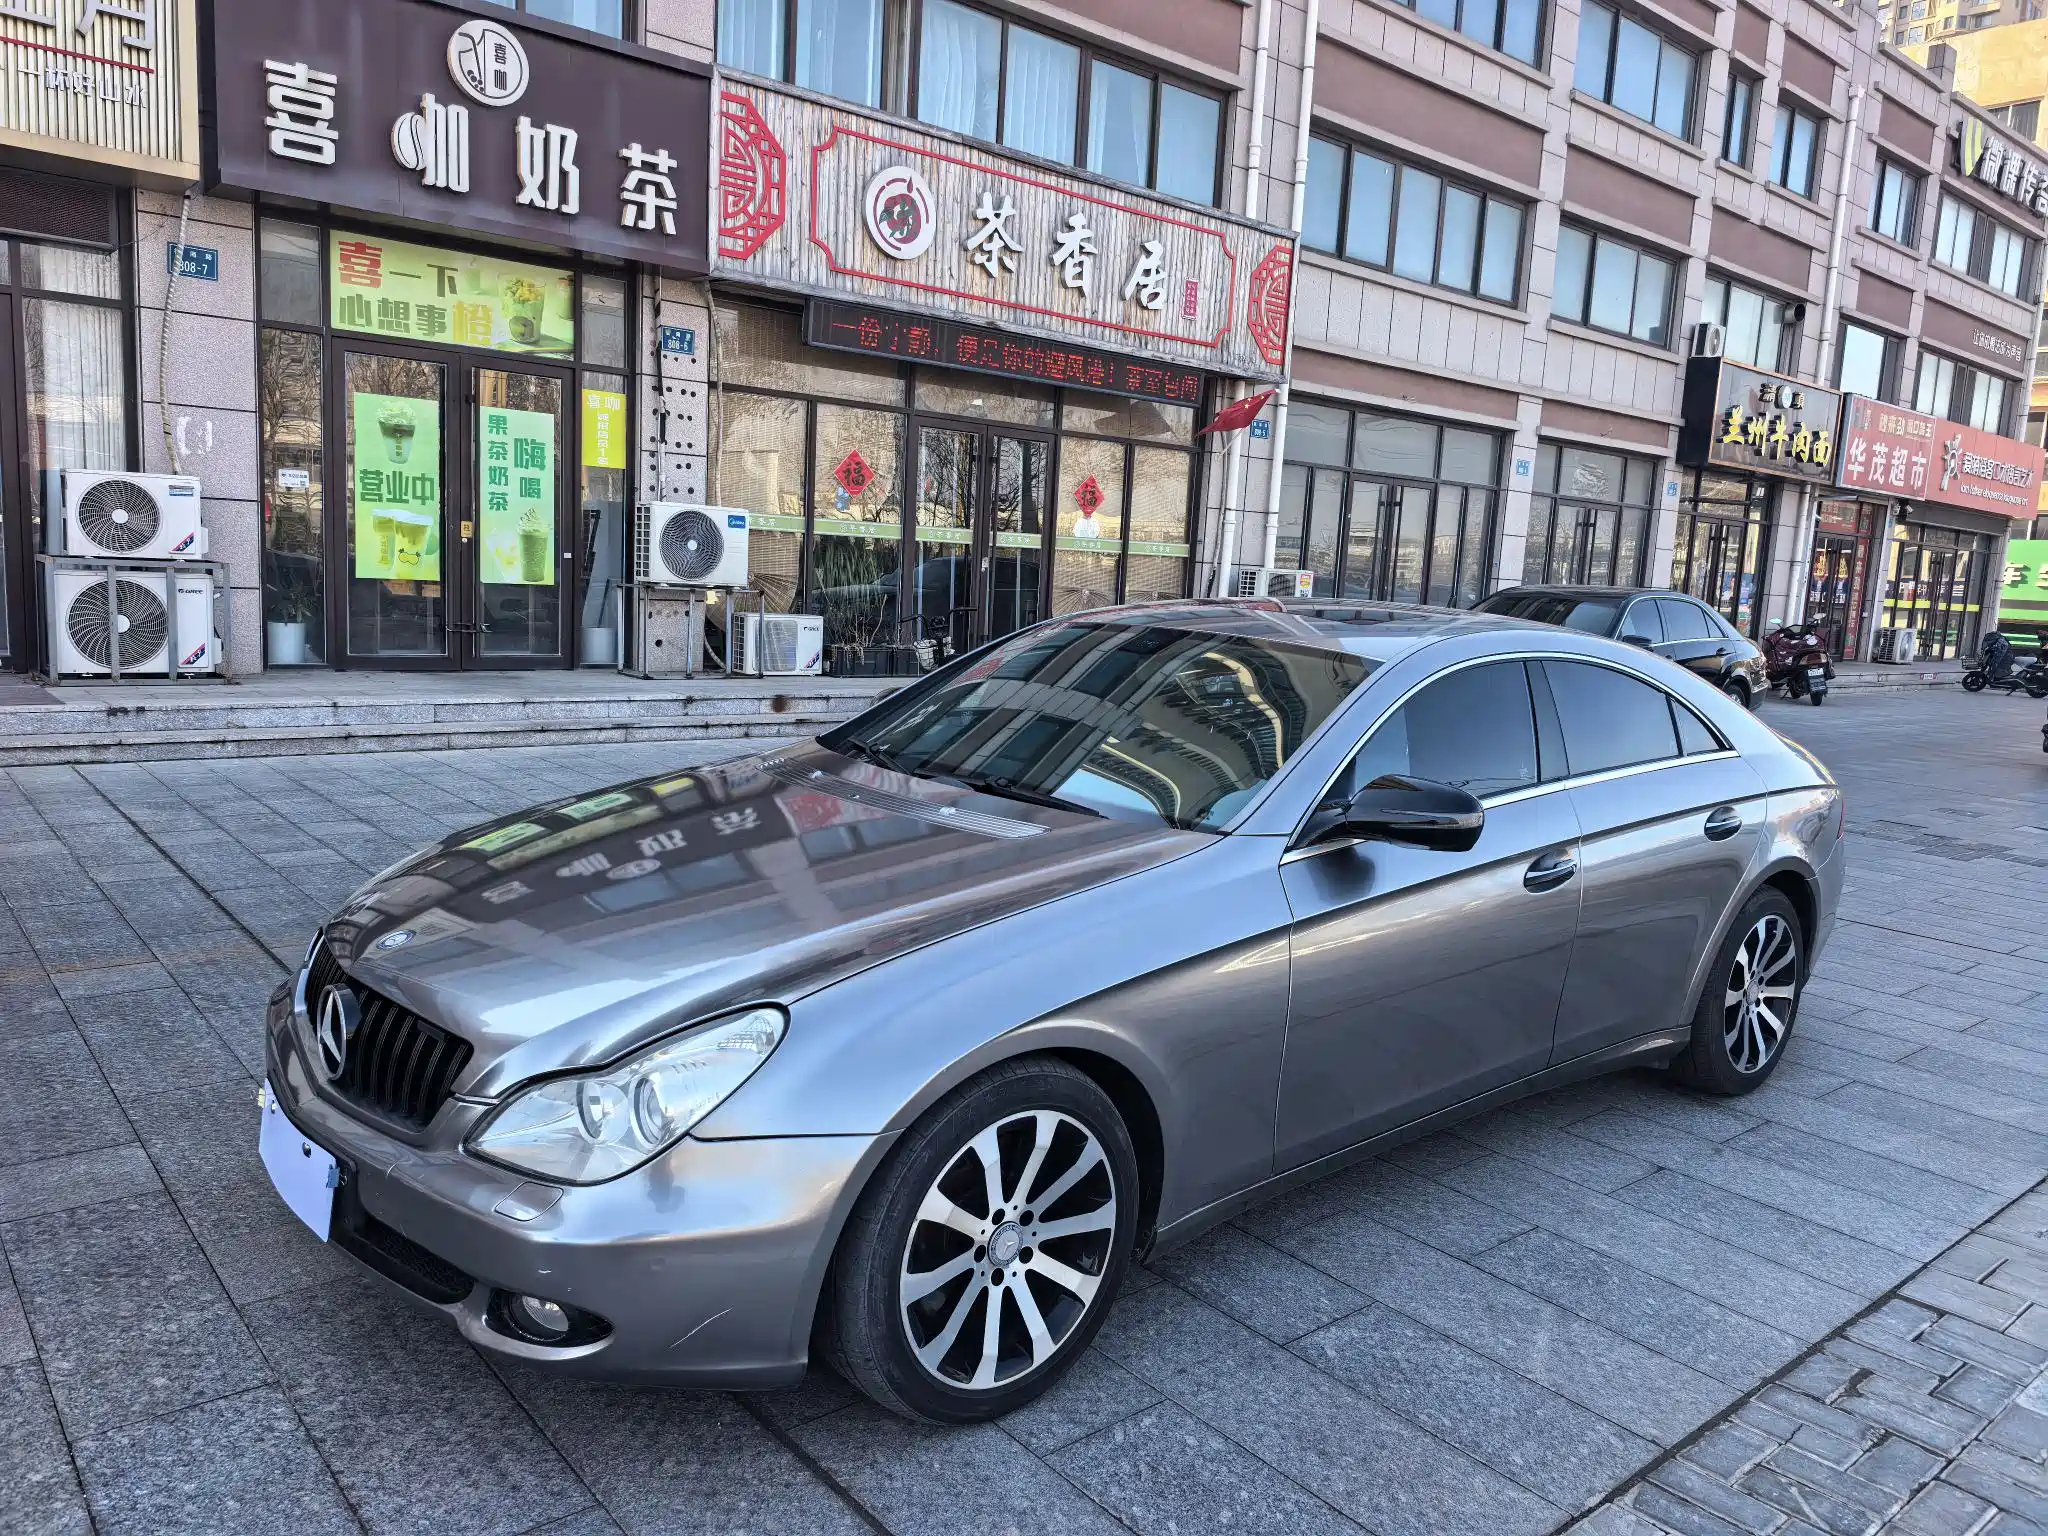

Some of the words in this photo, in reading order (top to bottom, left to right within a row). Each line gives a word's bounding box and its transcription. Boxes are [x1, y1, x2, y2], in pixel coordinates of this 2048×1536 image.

[494, 43, 507, 91] 喜咖
[263, 59, 679, 237] 喜咖奶茶
[338, 240, 459, 298] 喜一下
[966, 191, 1168, 310] 茶香居
[339, 293, 493, 346] 心想事橙
[487, 414, 509, 512] 果茶奶茶
[1722, 404, 1832, 467] 兰州牛肉面
[359, 468, 435, 506] 营业中
[513, 437, 547, 499] 嗨喝
[843, 461, 866, 487] 福
[1847, 437, 1928, 491] 华茂超市
[1080, 483, 1098, 508] 福
